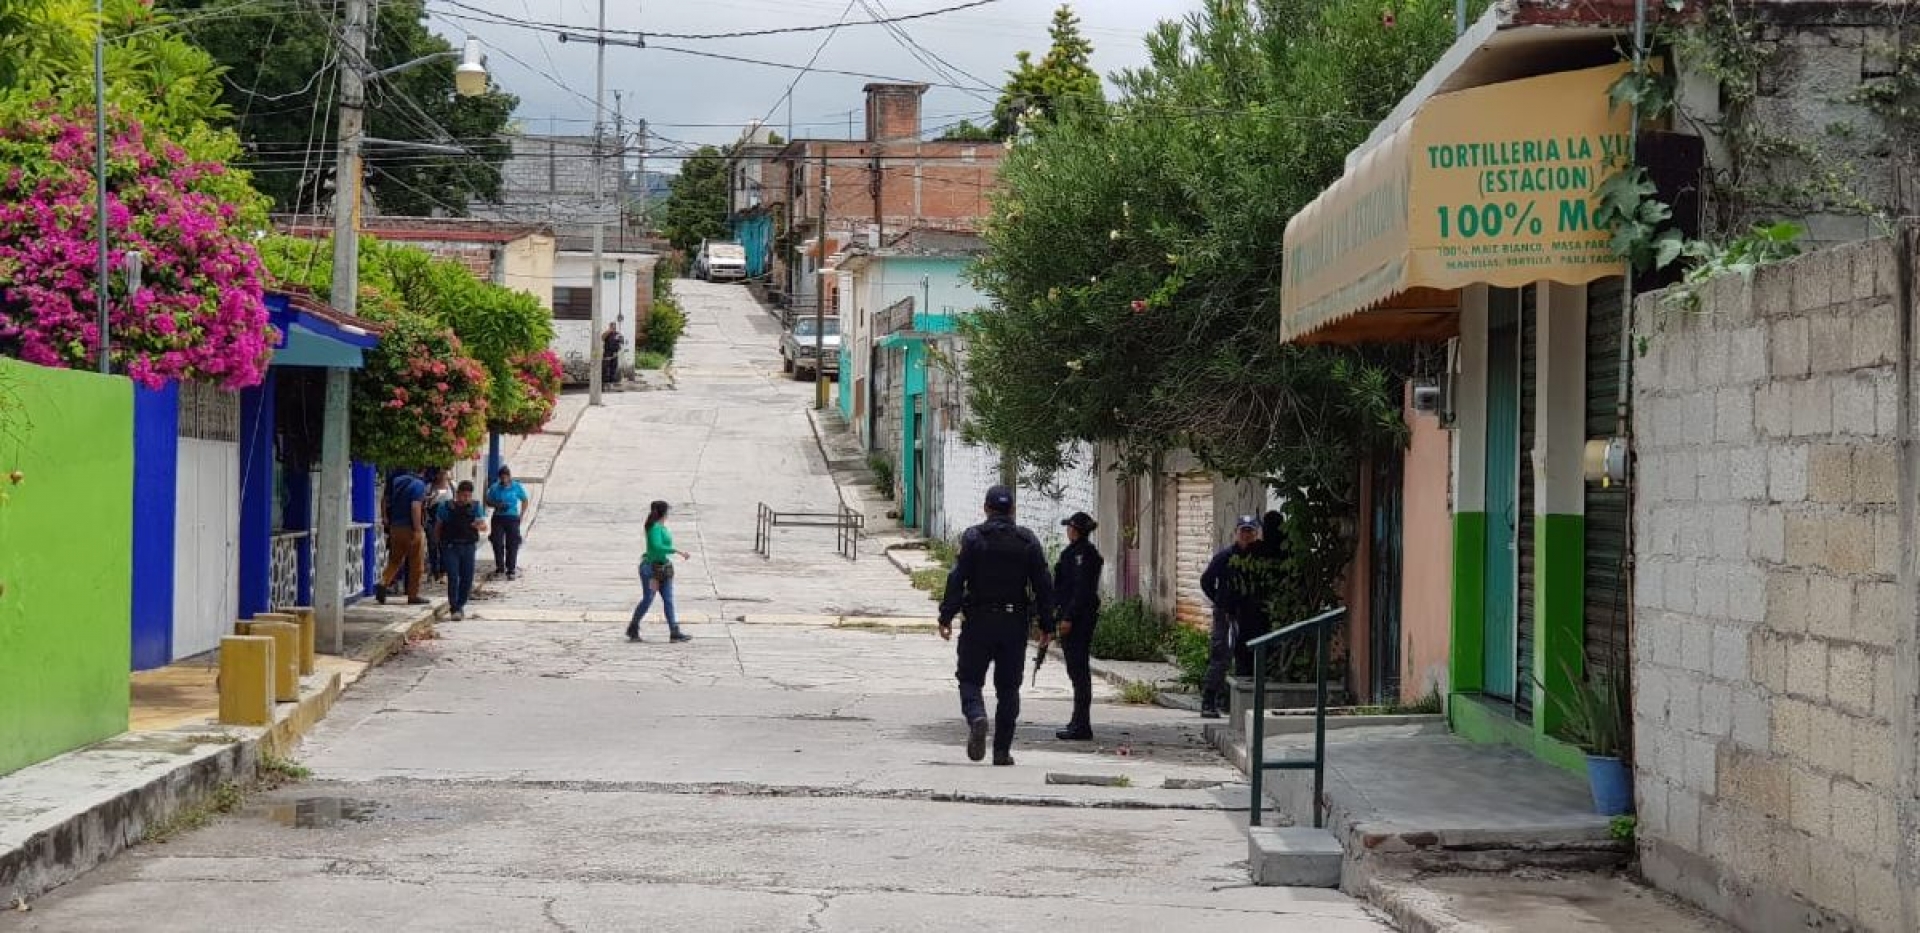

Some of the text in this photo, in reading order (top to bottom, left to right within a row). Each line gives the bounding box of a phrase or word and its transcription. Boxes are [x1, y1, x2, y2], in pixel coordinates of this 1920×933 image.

[1428, 138, 1560, 169] TORTILLERIA
[1567, 136, 1592, 160] LA
[1478, 165, 1594, 199] (ESTACION)
[1437, 200, 1543, 239] 100%
